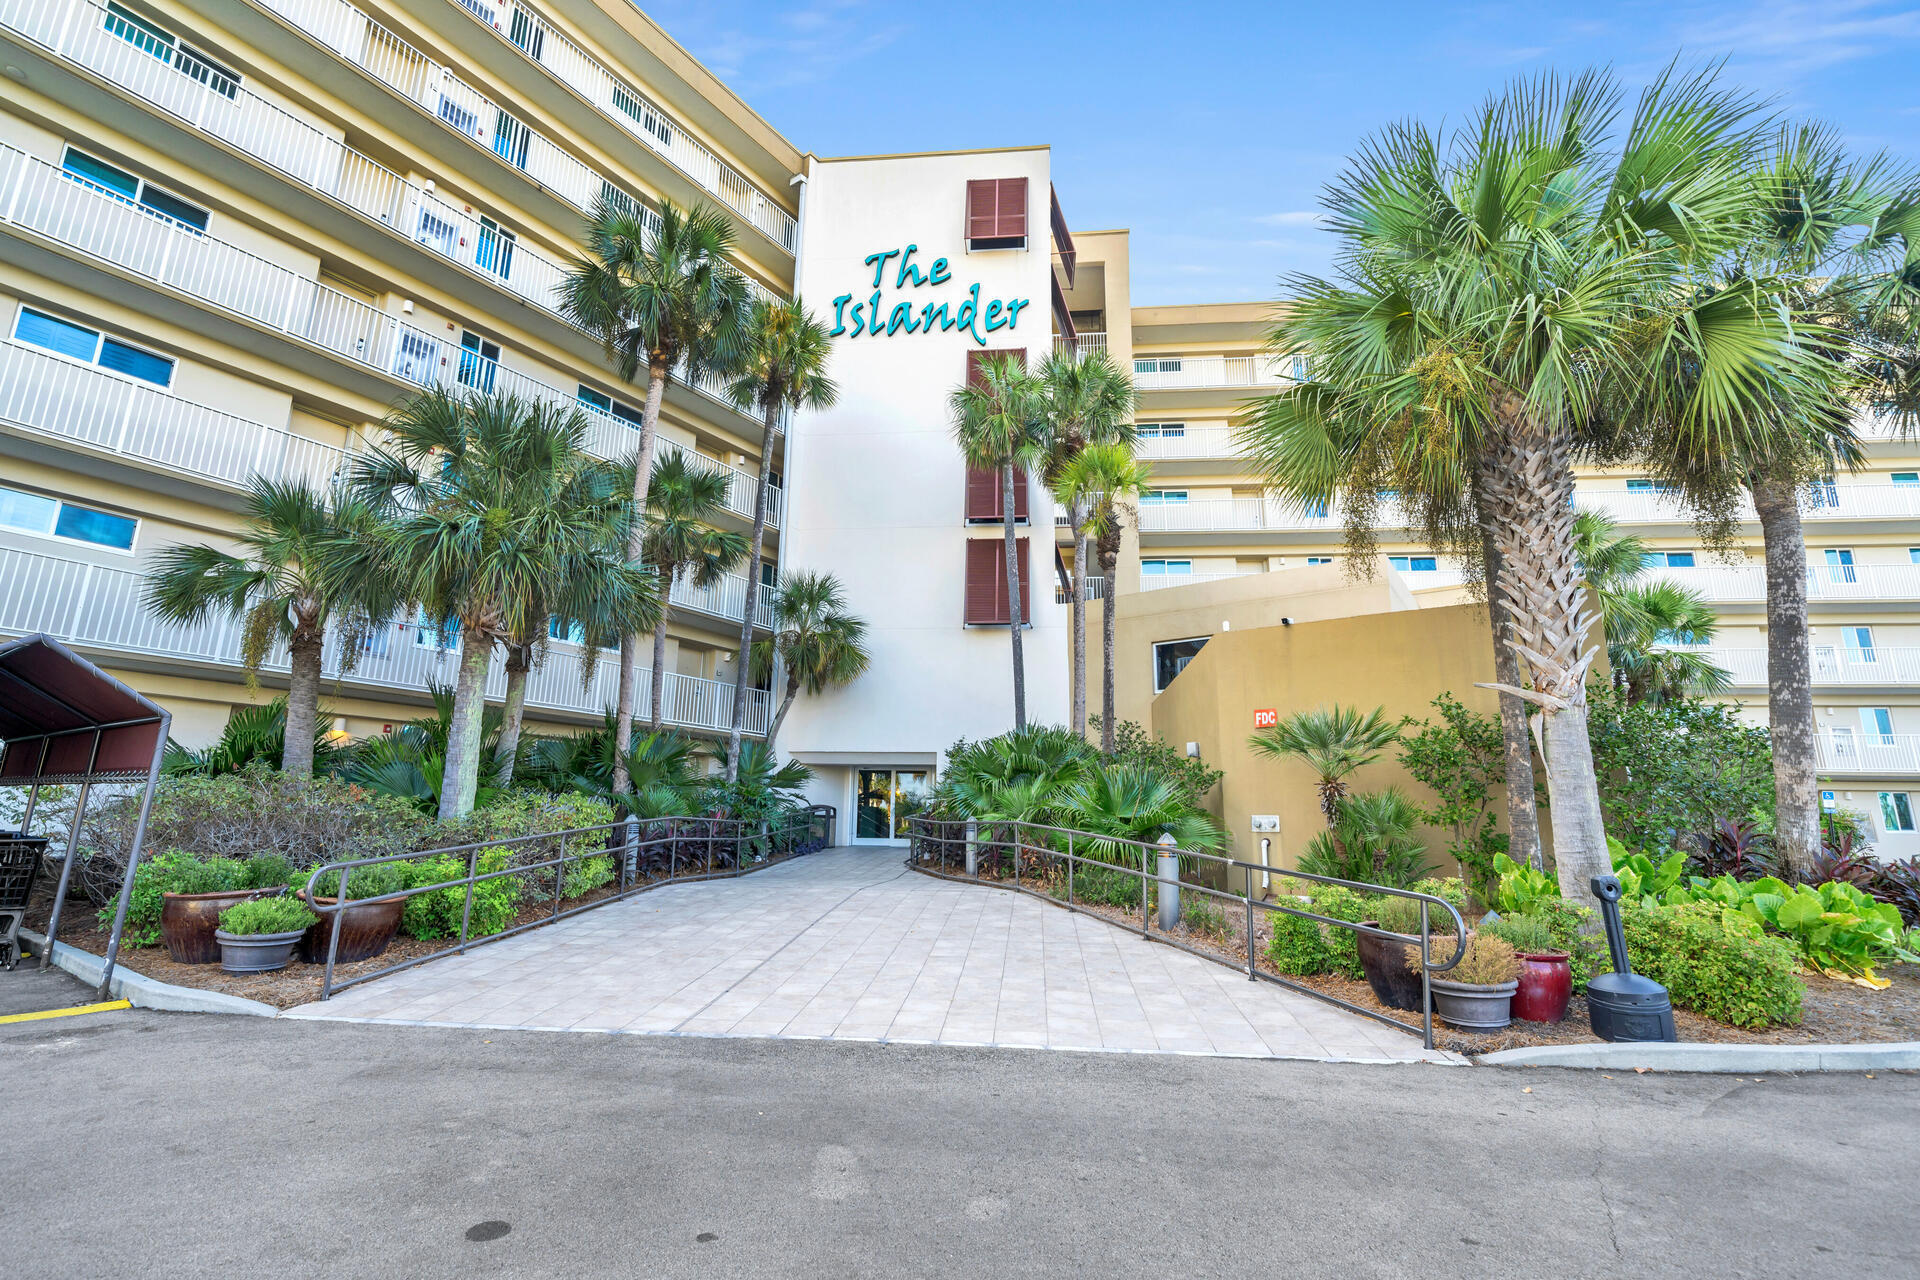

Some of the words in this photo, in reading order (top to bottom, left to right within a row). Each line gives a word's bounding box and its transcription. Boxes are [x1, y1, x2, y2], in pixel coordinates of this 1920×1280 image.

[865, 244, 951, 289] The
[829, 283, 1029, 346] Islander
[1255, 711, 1276, 725] FDC
